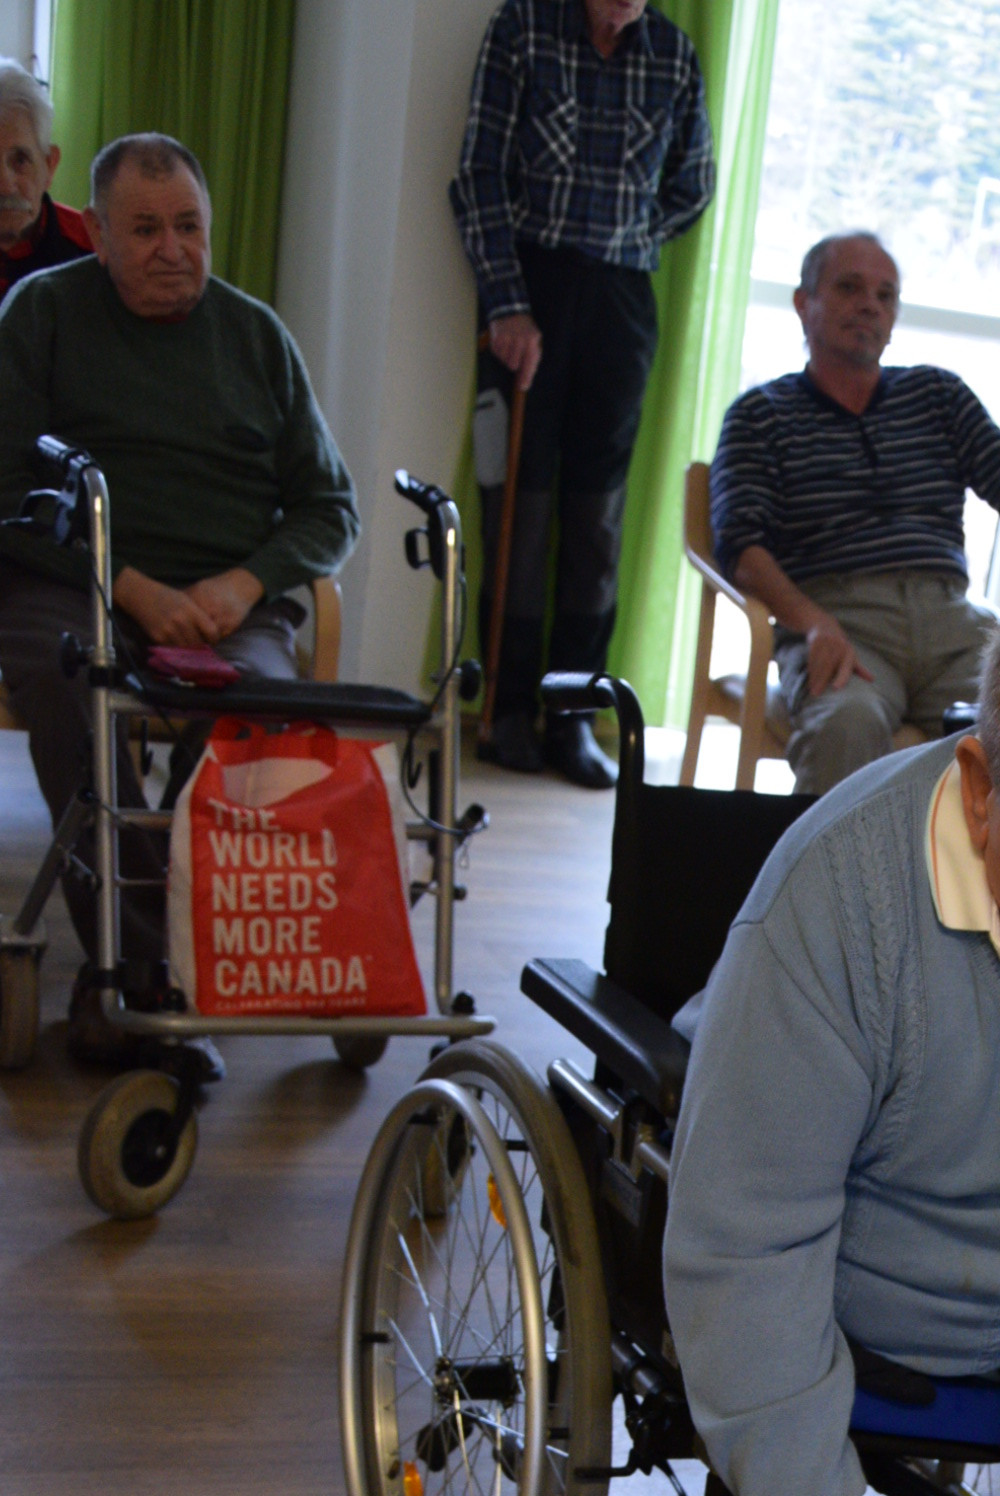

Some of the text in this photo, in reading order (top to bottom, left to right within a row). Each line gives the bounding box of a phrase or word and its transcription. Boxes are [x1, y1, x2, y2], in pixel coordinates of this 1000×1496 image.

[208, 798, 280, 831] THE
[211, 872, 338, 912] NEEDS
[213, 916, 322, 955] MORE
[214, 955, 367, 997] CANADA
